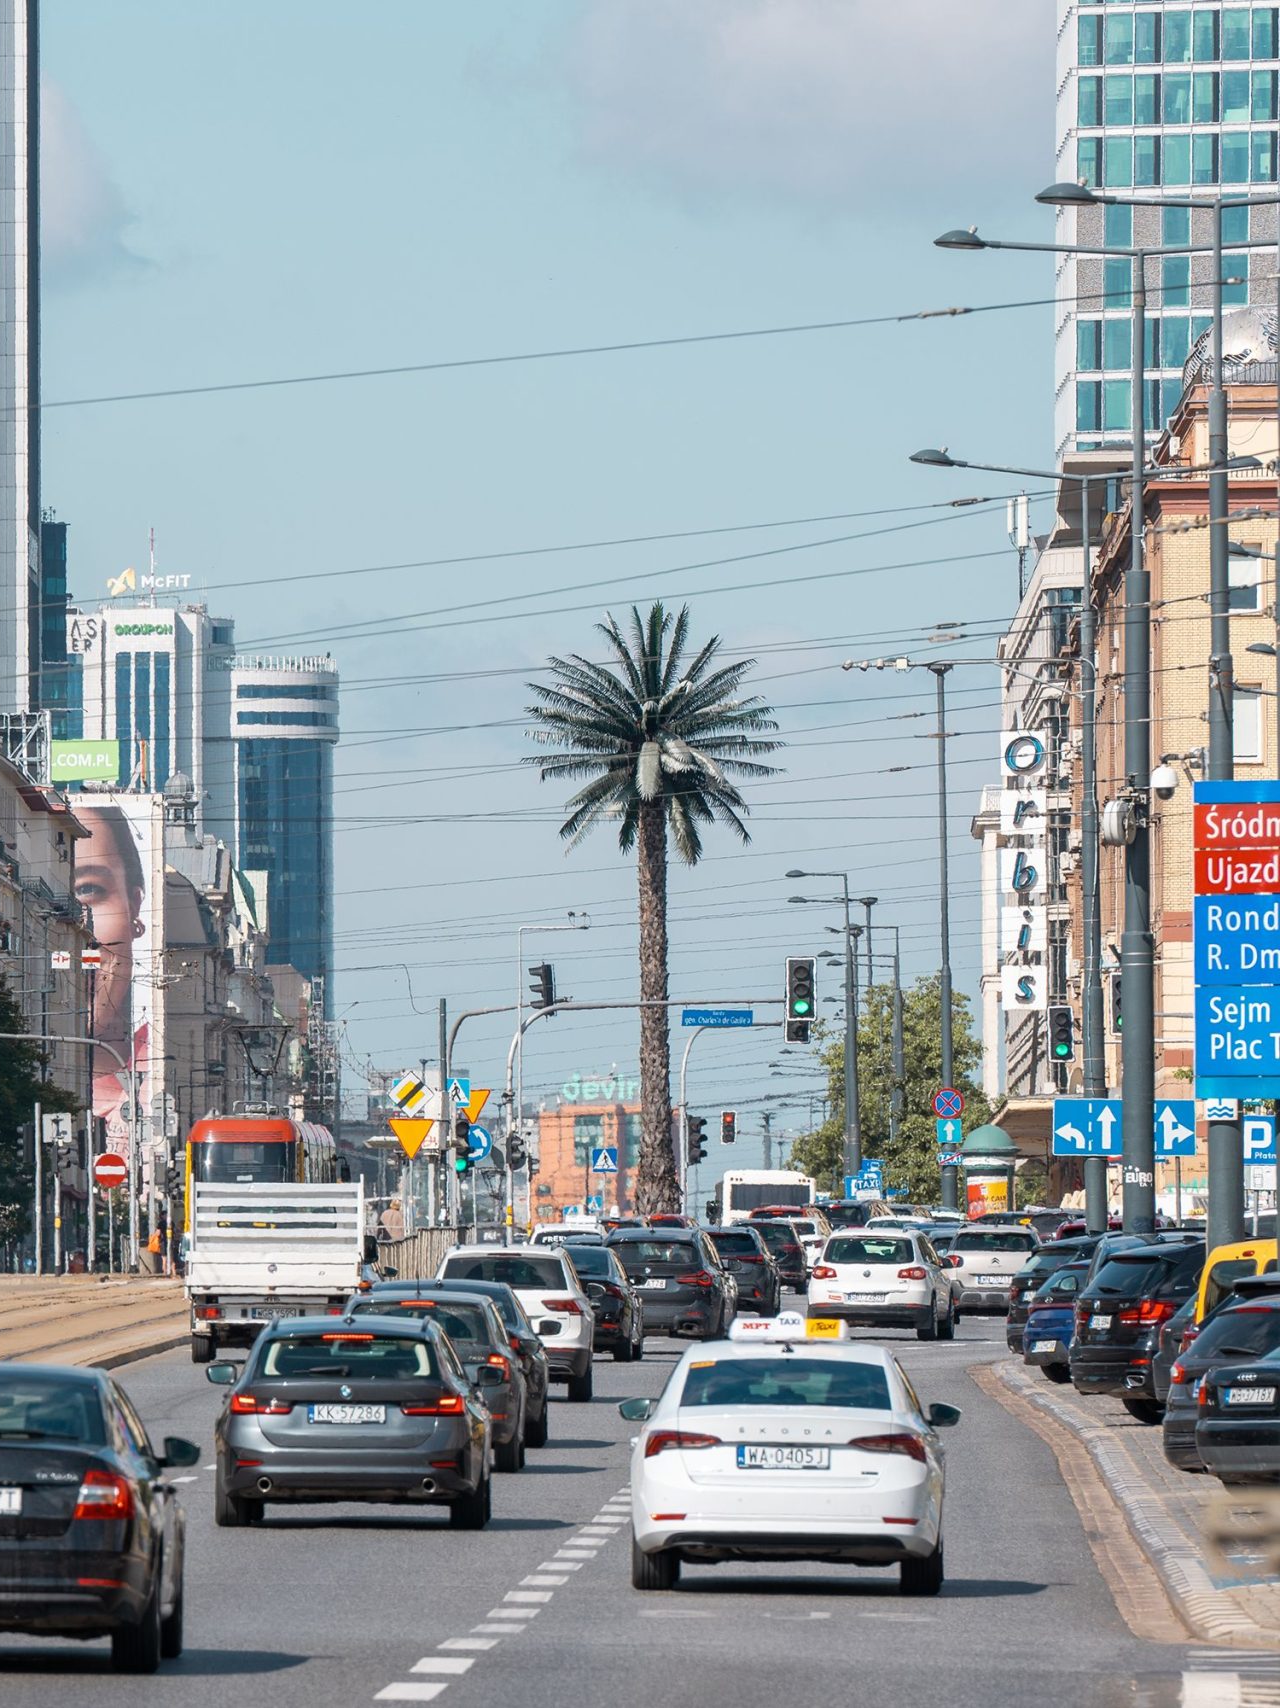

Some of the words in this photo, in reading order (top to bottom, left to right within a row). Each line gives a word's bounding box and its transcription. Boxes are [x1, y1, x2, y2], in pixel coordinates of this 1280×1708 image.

[141, 574, 191, 588] McFIT
[114, 623, 174, 636] GROUPON
[1207, 854, 1280, 892] Ujazd
[1207, 902, 1280, 932] Rond
[1207, 943, 1230, 970] R.
[1209, 995, 1271, 1031] Sejm
[1210, 1031, 1263, 1061] Plac
[1125, 1172, 1153, 1184] EURO
[742, 1322, 771, 1330] MPT
[778, 1317, 801, 1326] TAXI
[317, 1404, 335, 1420] KK
[341, 1404, 382, 1420] 57286
[748, 1447, 769, 1464] WA
[775, 1448, 824, 1464] 0405J
